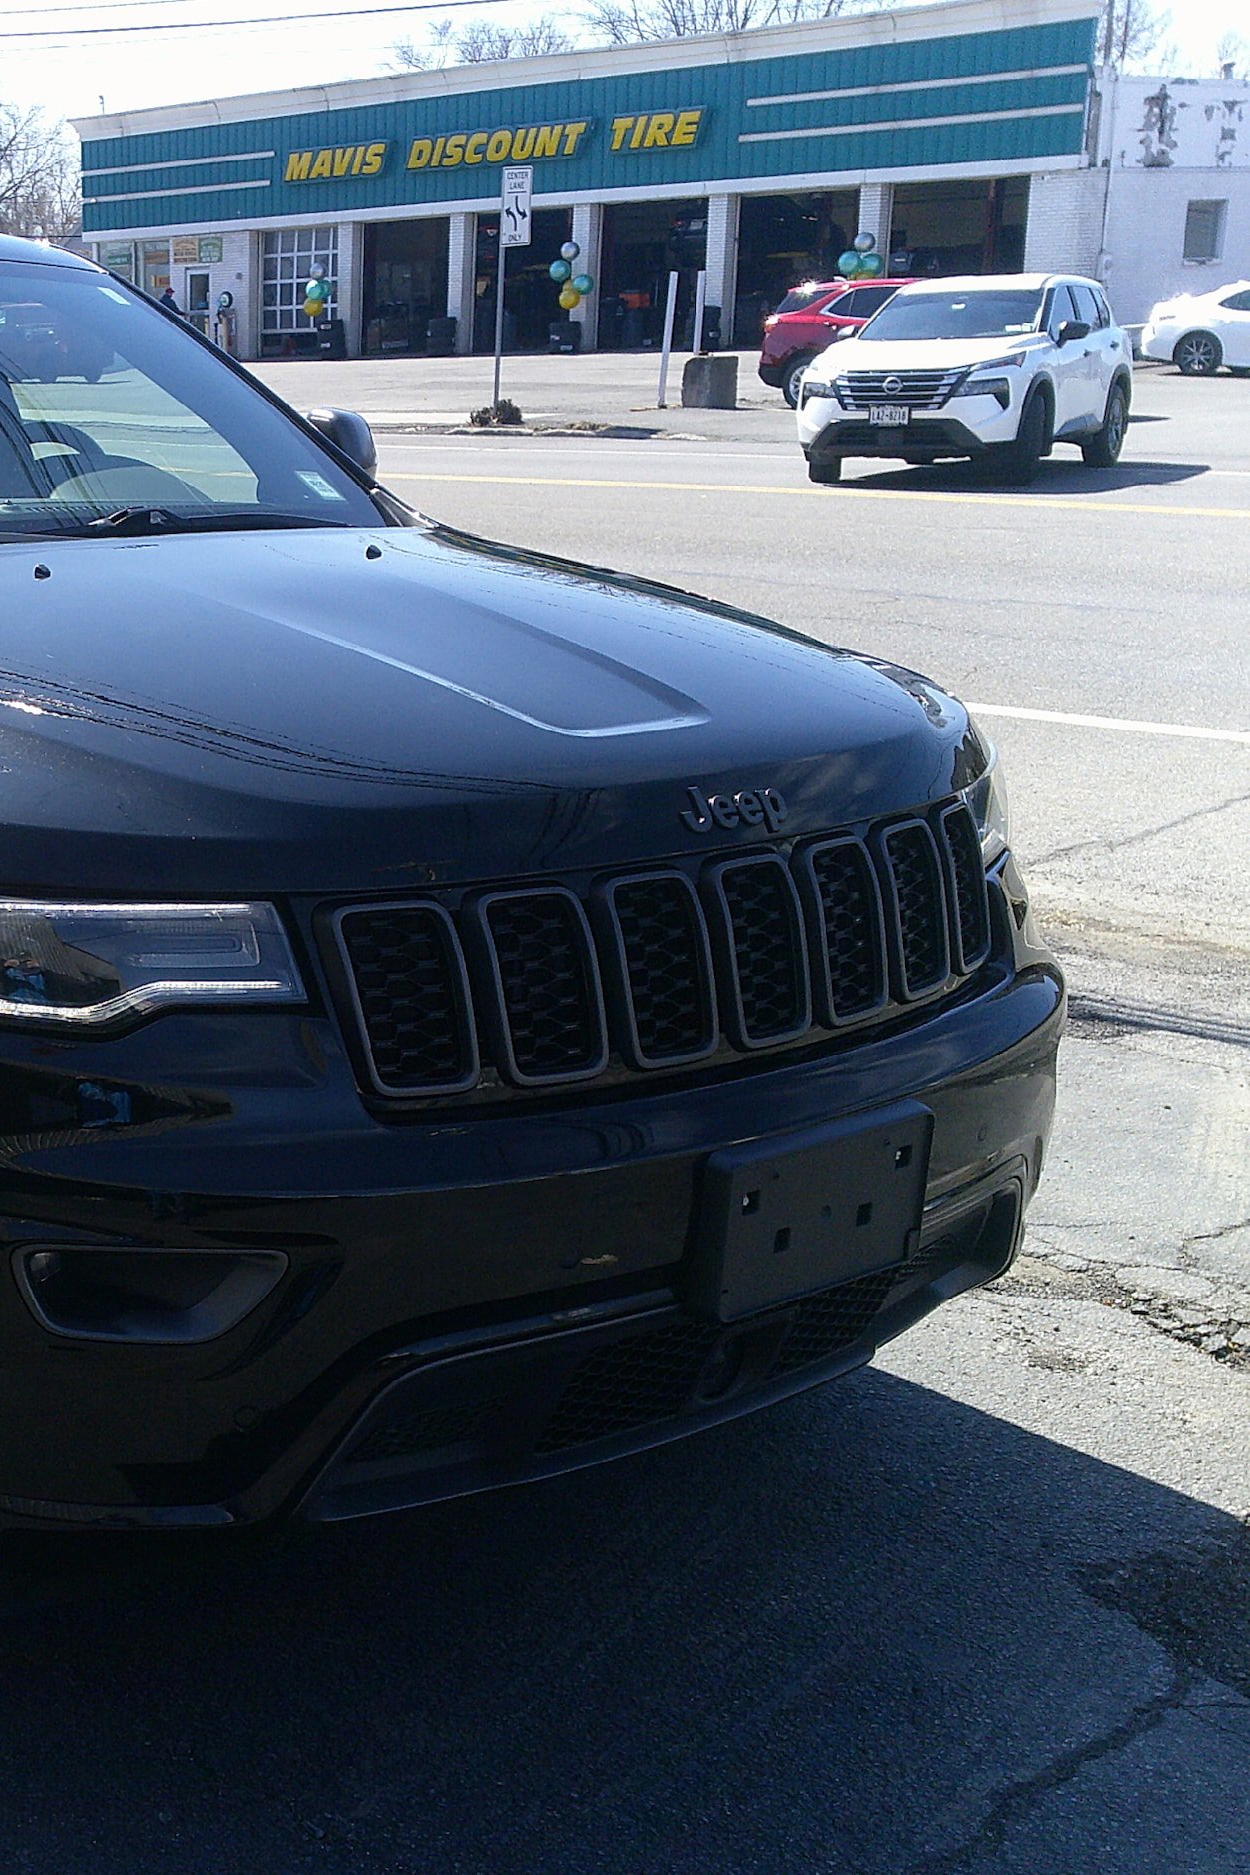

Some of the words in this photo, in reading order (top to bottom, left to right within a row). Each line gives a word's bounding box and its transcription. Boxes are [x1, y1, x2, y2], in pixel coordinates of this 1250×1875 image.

[283, 143, 386, 181] MAVIS
[406, 121, 587, 170] DISCOUNT
[610, 110, 702, 151] TIRE
[507, 171, 529, 180] CENTER
[509, 181, 525, 190] LANE
[507, 232, 522, 242] ONLY
[679, 785, 790, 834] Jeep
